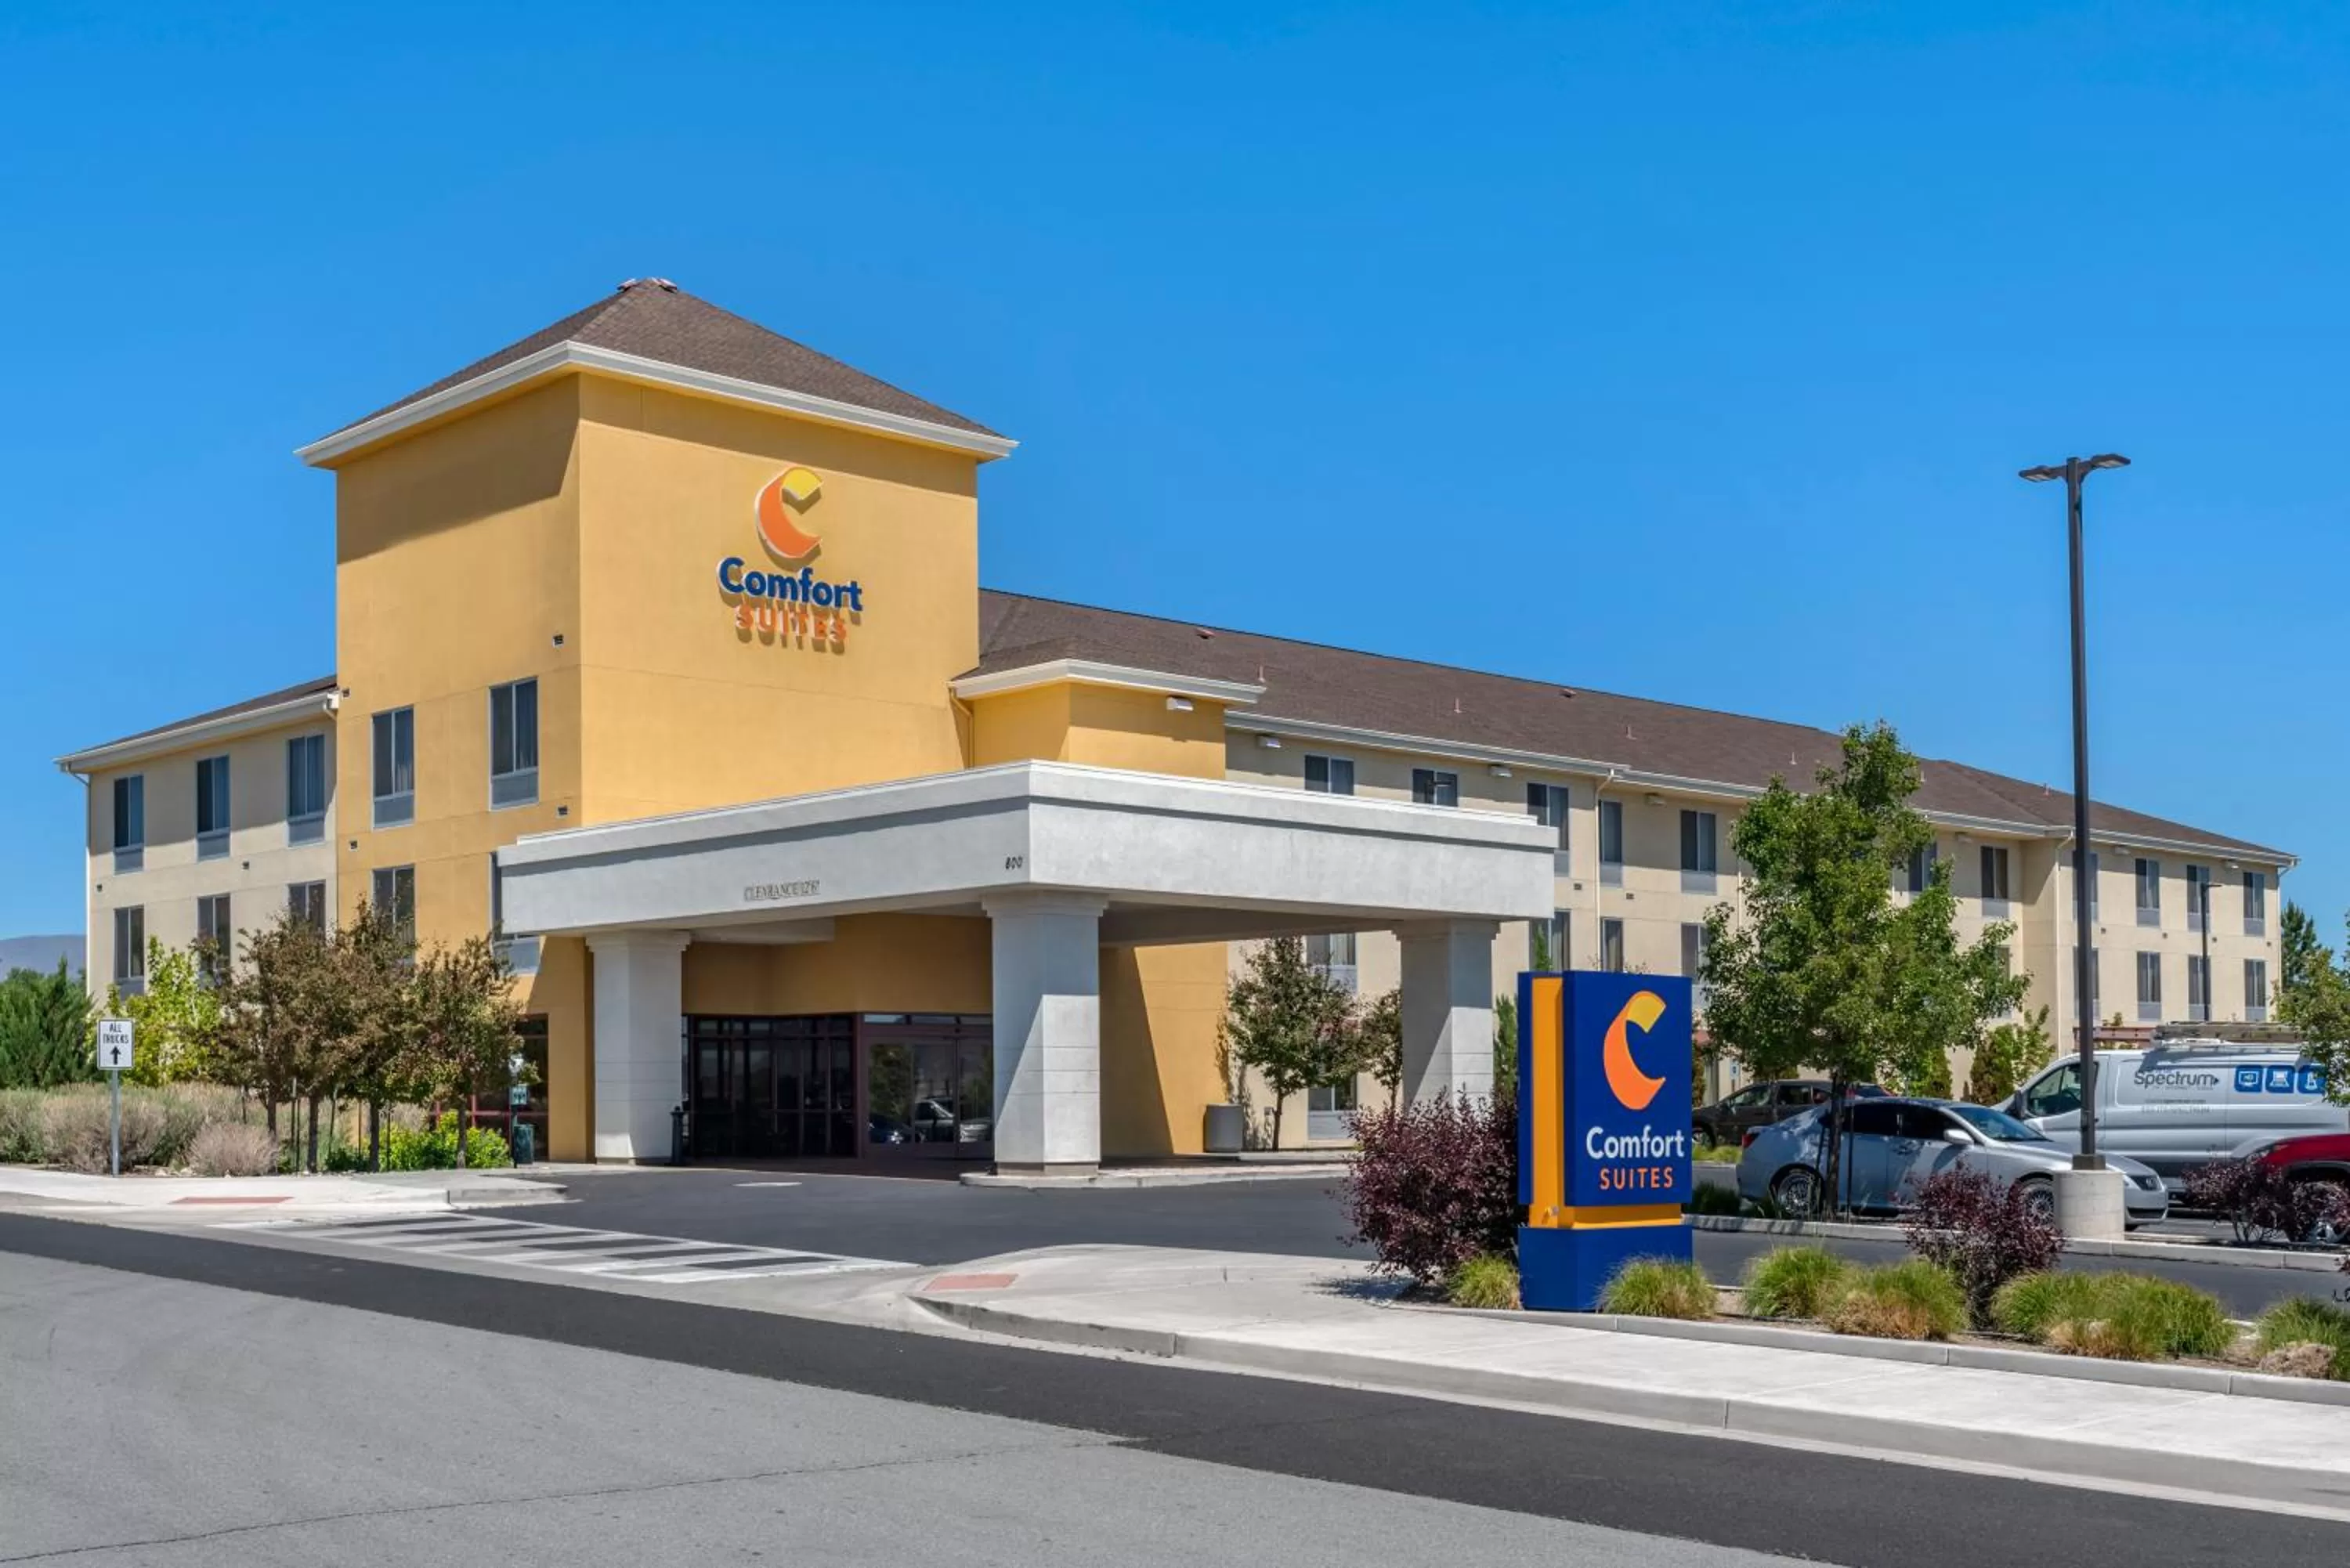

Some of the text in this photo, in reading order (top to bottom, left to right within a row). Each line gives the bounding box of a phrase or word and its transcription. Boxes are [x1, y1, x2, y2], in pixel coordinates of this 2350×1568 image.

[716, 556, 863, 612] Comfort
[735, 602, 847, 642] SUITES
[103, 1033, 129, 1044] TRUCKS
[109, 1023, 122, 1033] ALL
[2134, 1071, 2214, 1089] Spectrum
[1586, 1125, 1684, 1159] Comfort
[1600, 1166, 1673, 1190] SUITES
